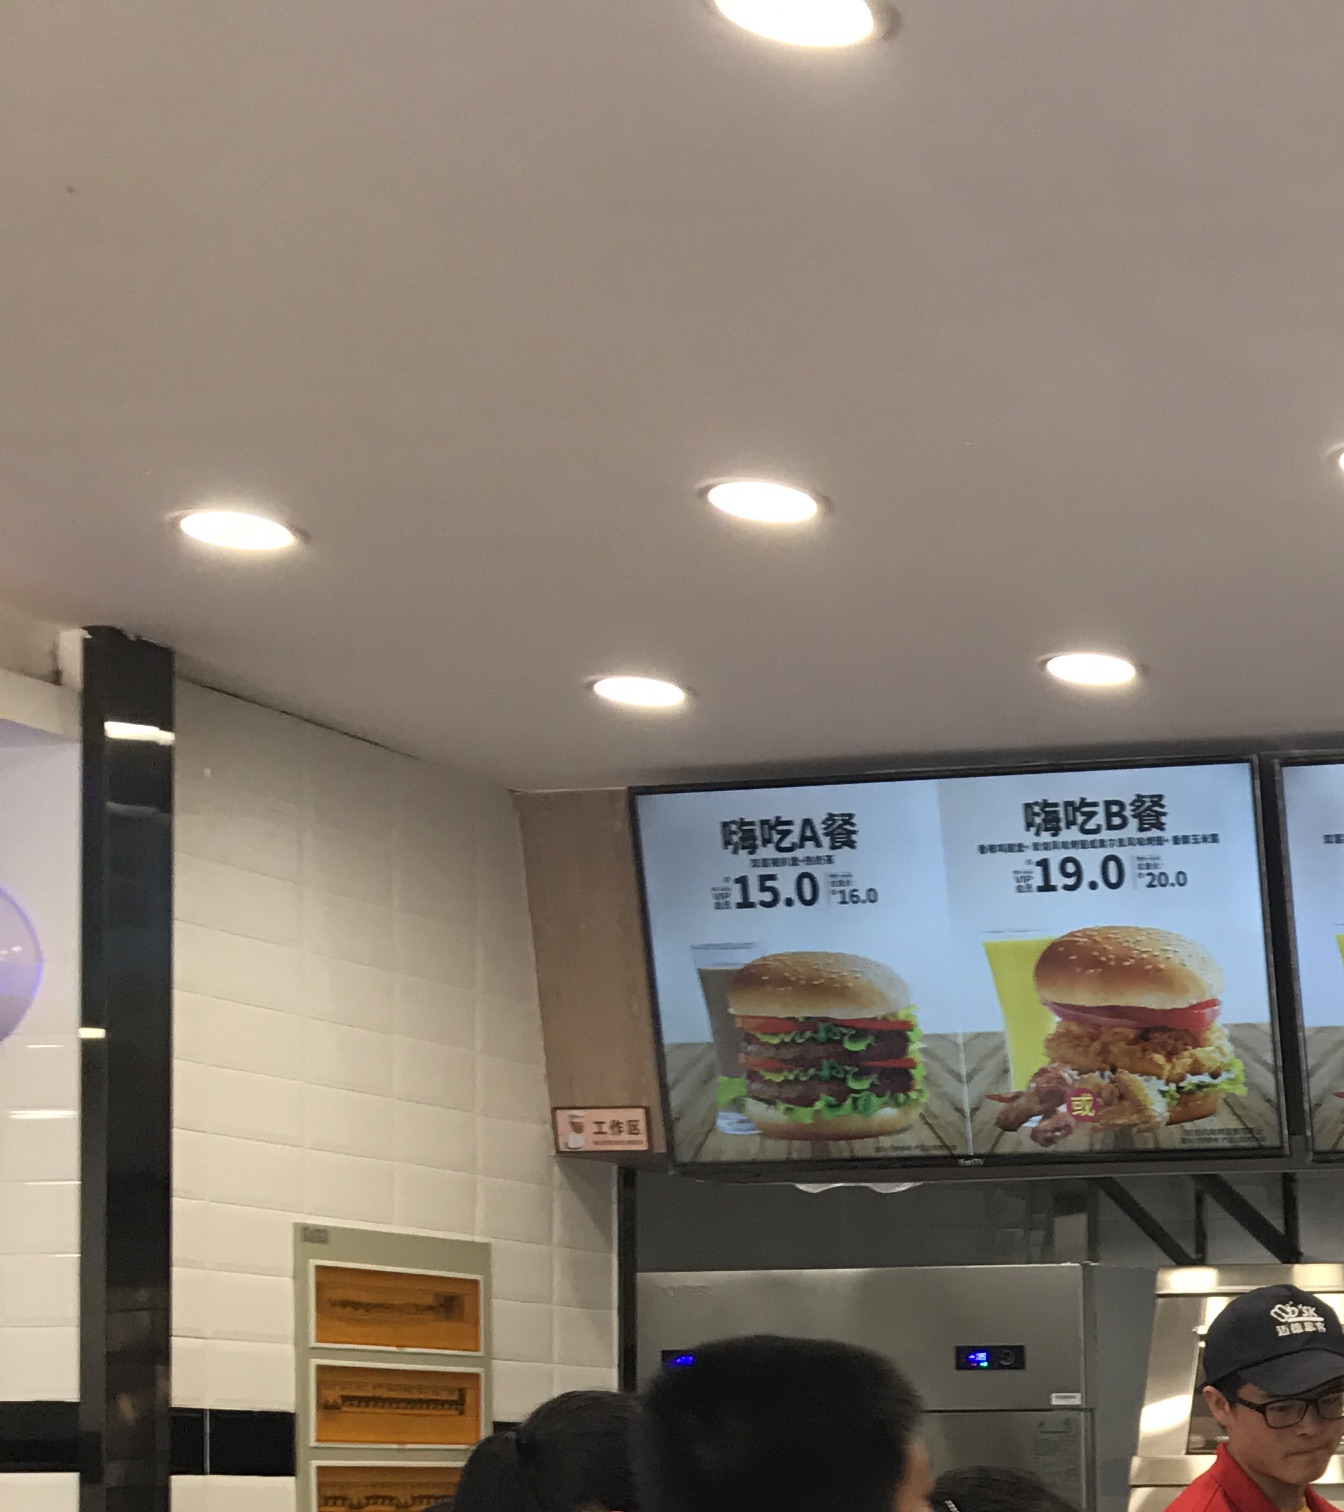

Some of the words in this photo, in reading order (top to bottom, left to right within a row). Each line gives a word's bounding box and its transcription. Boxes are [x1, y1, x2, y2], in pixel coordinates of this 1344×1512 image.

[1023, 793, 1167, 837] 嗨吃B餐
[720, 812, 859, 855] 嗨吃A餐
[1036, 854, 1126, 892] 19.0
[1145, 870, 1188, 889] 20.0
[733, 872, 820, 909] 15.0
[837, 888, 878, 904] 16.0
[1070, 1091, 1095, 1119] 或
[593, 1120, 641, 1136] 工作区
